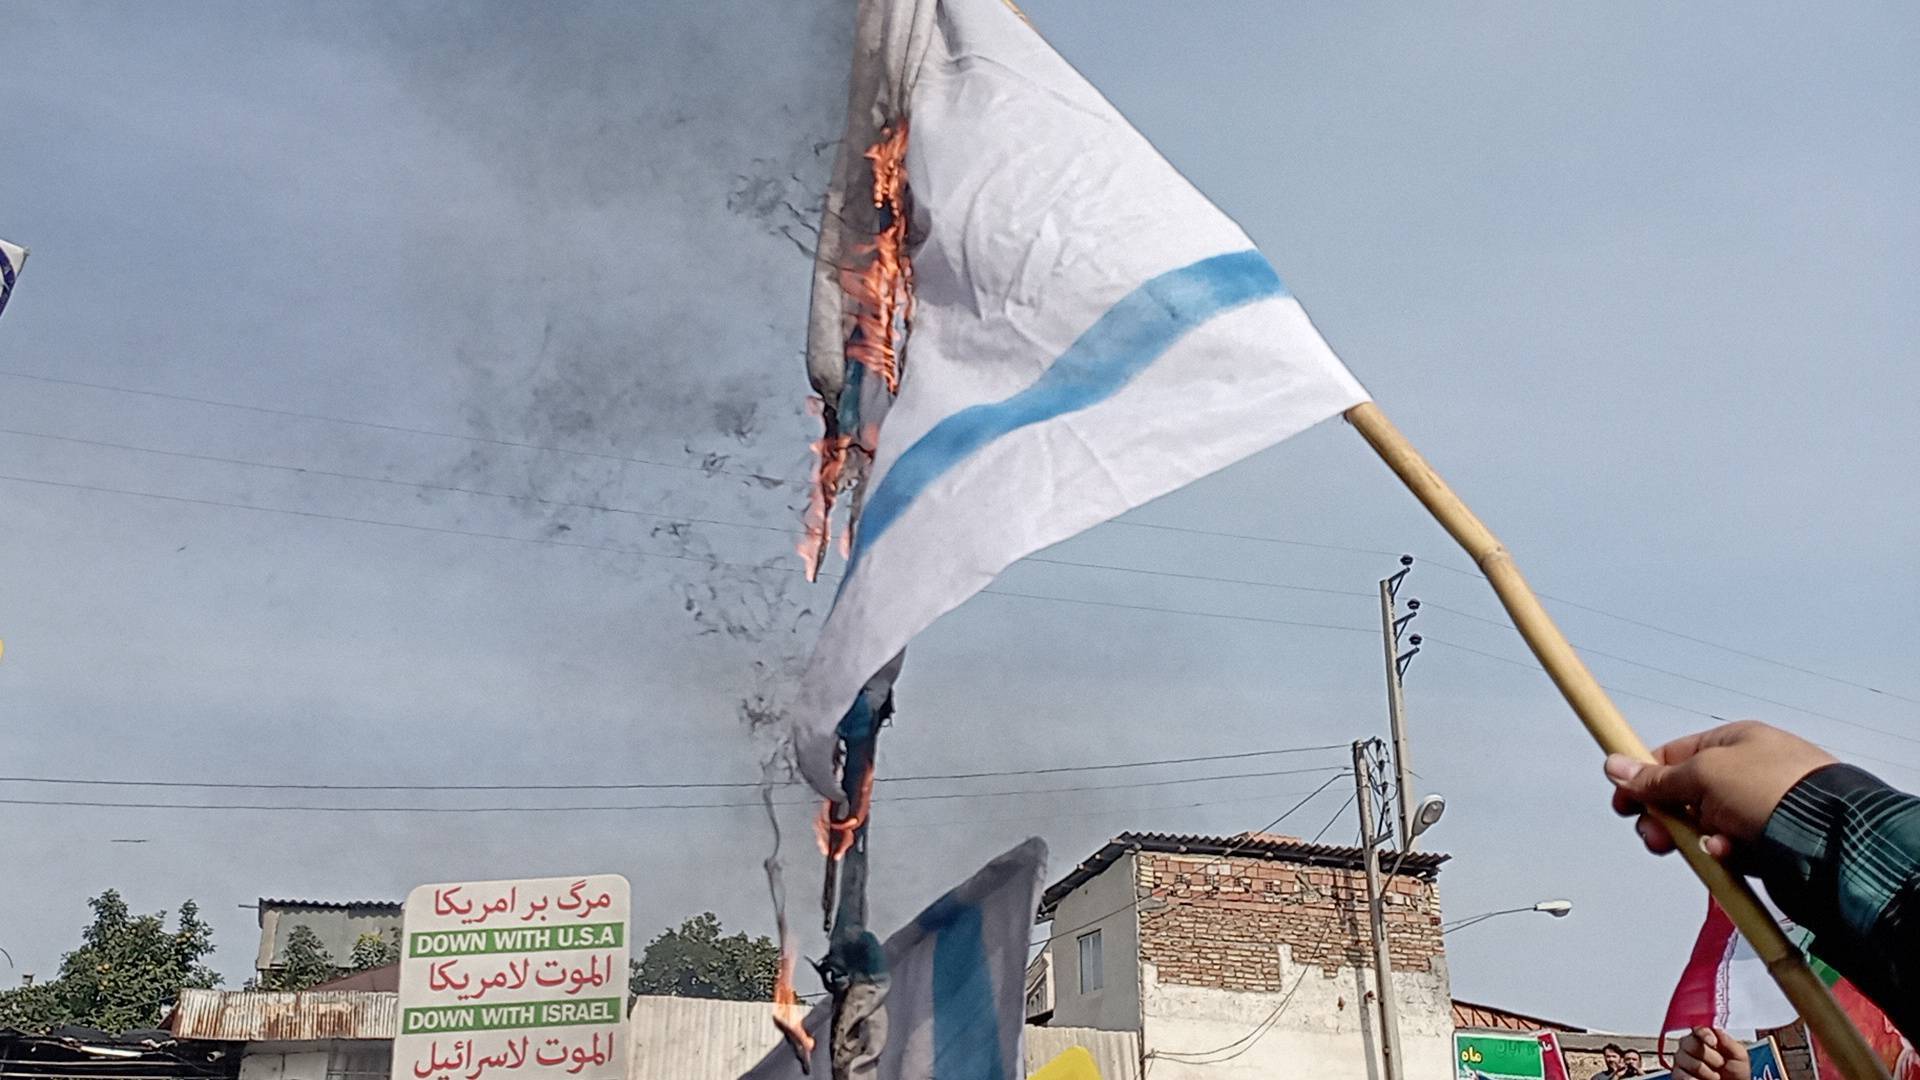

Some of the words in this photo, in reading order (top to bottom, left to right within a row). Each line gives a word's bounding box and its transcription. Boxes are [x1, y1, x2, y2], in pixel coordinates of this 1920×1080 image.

[520, 895, 548, 921] بر
[557, 879, 611, 918] مرگ
[416, 931, 487, 954] DOWN
[493, 929, 551, 950] WITH
[557, 926, 616, 947] U.S.A
[535, 954, 612, 994] الموت
[408, 1008, 475, 1030] DOWN
[481, 1005, 535, 1026] WITH
[542, 1002, 614, 1023] ISRAEL
[536, 1032, 614, 1074] الموت
[1461, 1045, 1482, 1063] ماه
